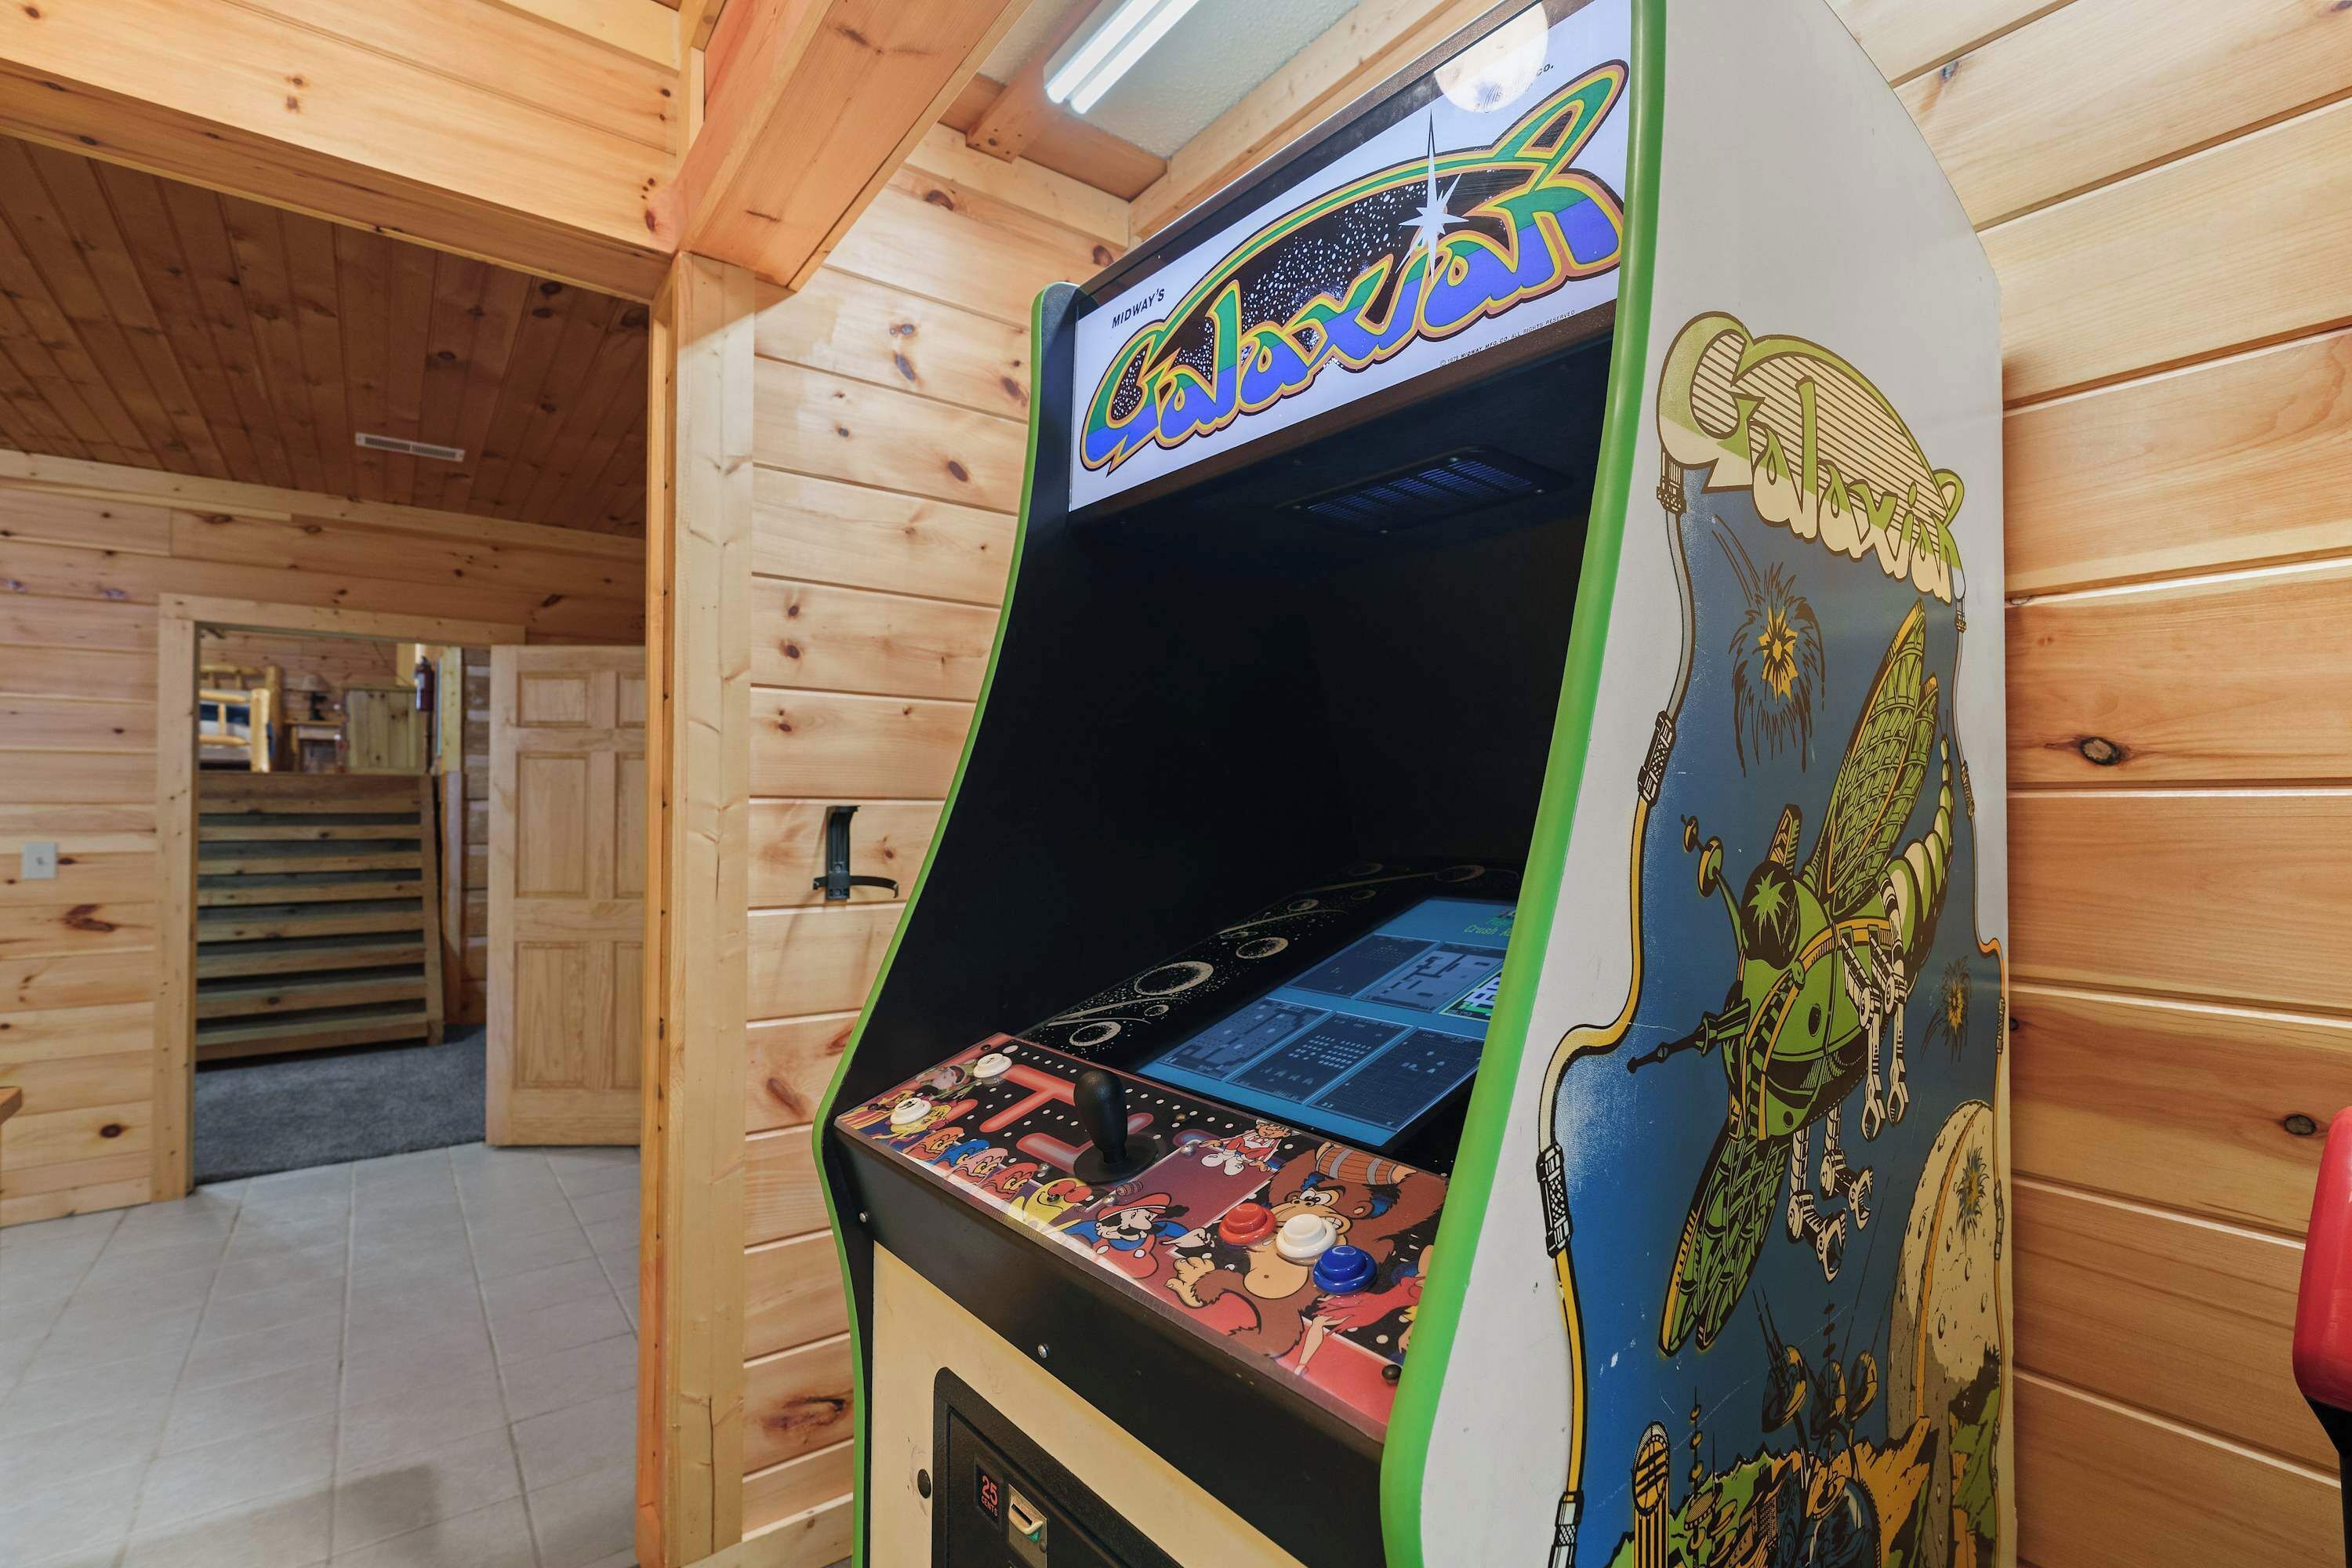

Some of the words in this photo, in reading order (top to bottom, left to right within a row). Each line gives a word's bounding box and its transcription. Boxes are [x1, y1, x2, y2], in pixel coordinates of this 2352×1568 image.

[1112, 288, 1165, 329] MIDWAY'S
[1461, 347, 1483, 358] MIDWAY
[1523, 322, 1544, 334] RIGHTS
[1545, 310, 1575, 325] RESERVED
[1657, 311, 1966, 605] Galaxian
[982, 1475, 998, 1506] 25
[982, 1496, 998, 1516] CENTS
